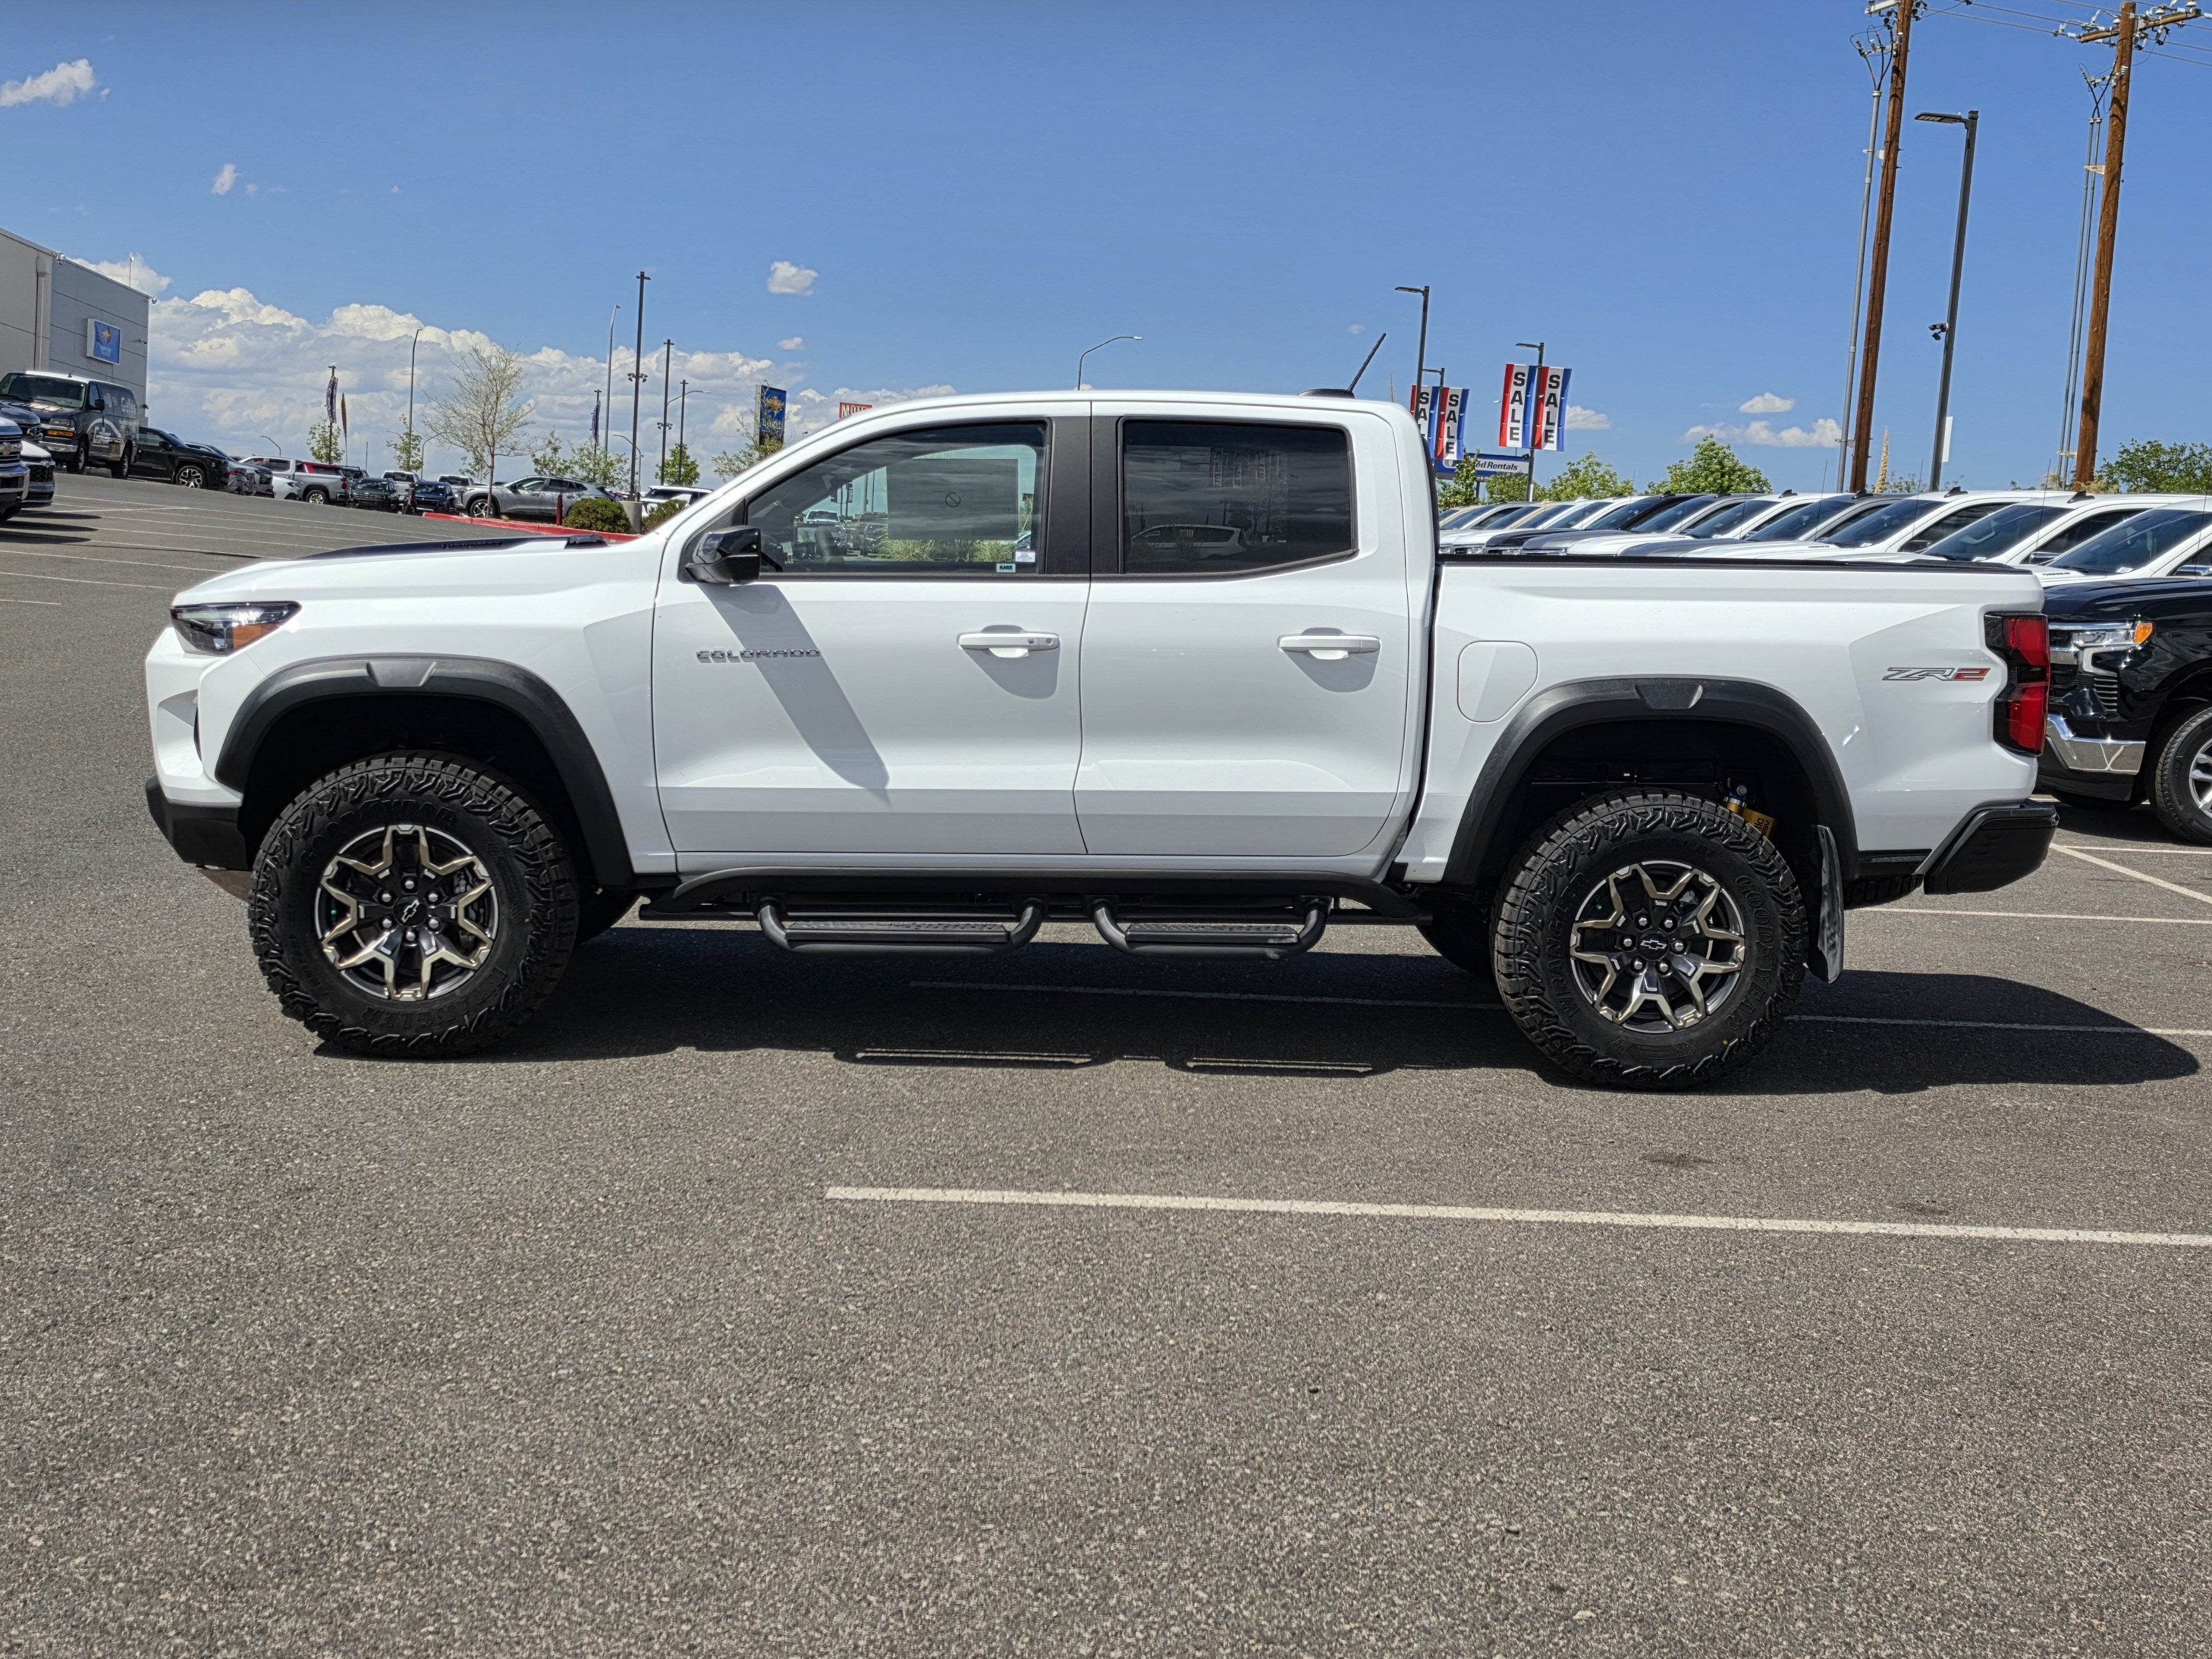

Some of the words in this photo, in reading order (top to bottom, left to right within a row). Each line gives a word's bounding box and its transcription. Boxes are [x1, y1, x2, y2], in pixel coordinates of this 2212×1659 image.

[1418, 392, 1430, 437] SAL
[1446, 393, 1459, 455] SALE
[1509, 372, 1526, 441] SALE
[1544, 374, 1560, 444] SALE
[1487, 461, 1519, 471] Rentals
[696, 649, 820, 659] COLORADO
[1881, 667, 1991, 681] ZR2
[1724, 875, 1773, 1030] GOODYEAR
